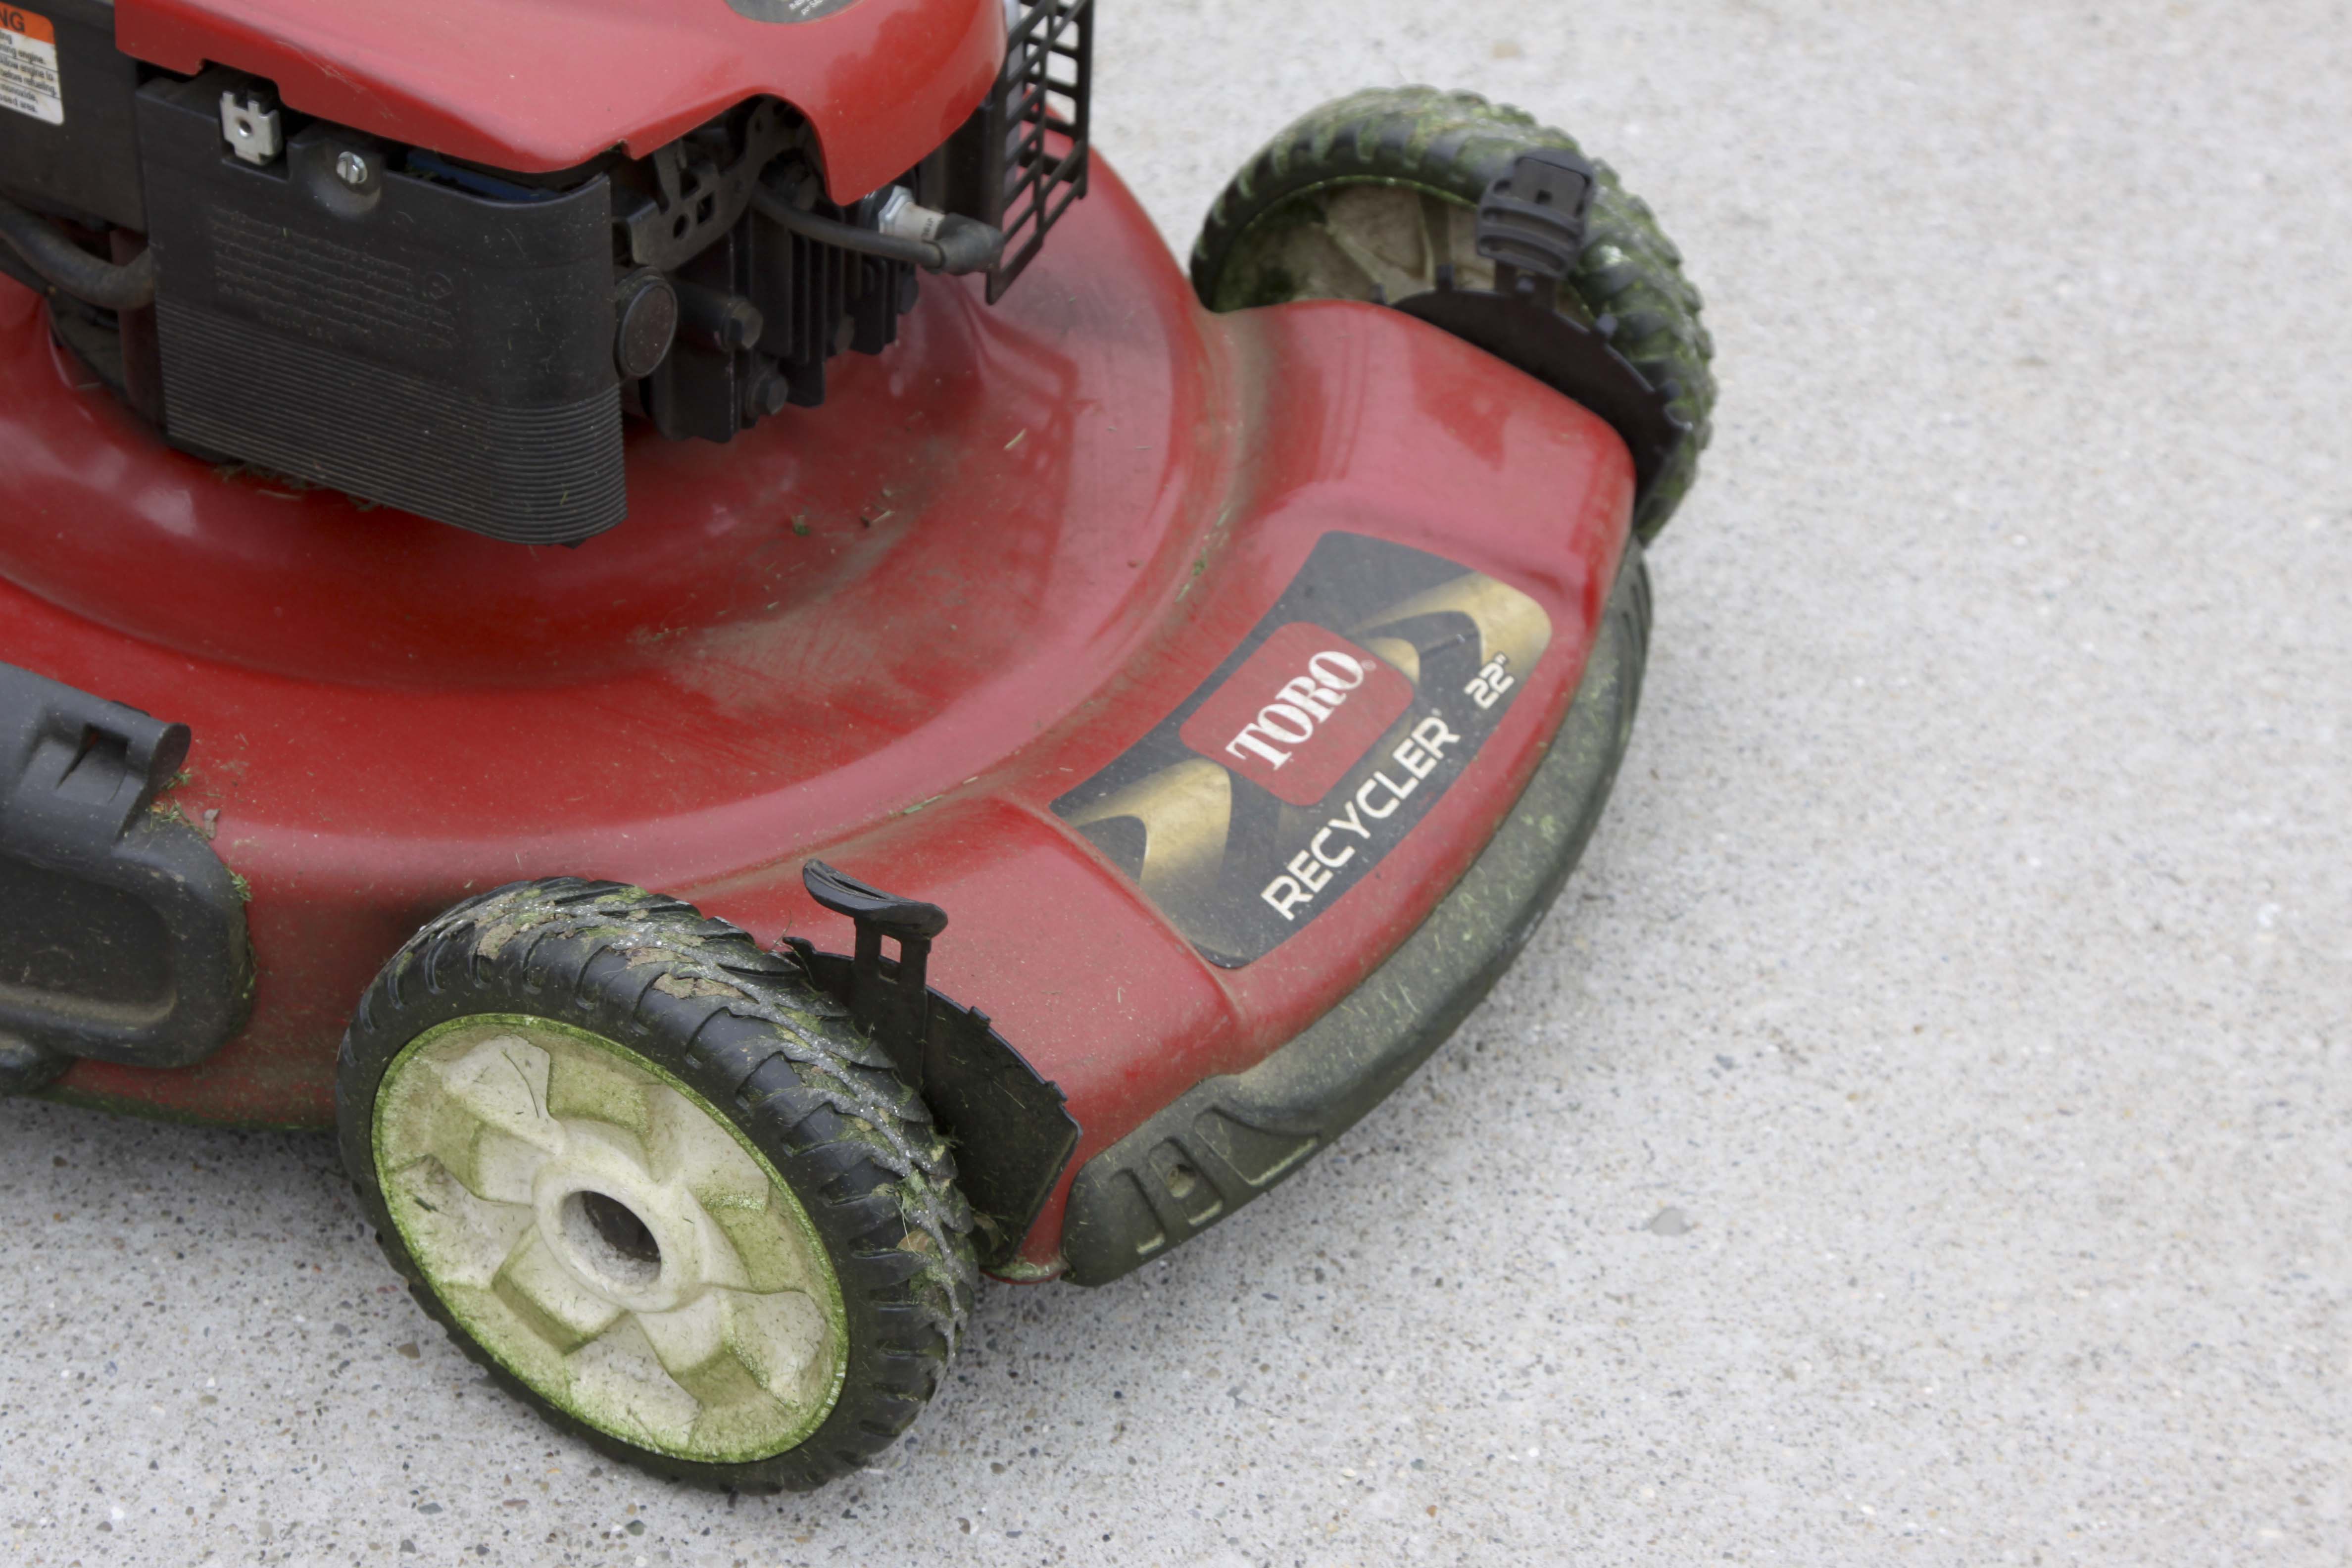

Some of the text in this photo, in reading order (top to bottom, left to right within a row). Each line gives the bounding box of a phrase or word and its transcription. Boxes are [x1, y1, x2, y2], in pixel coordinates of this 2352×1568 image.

[20, 63, 44, 78] engine
[1225, 651, 1364, 771] TORO
[1260, 717, 1461, 921] RECYCLER
